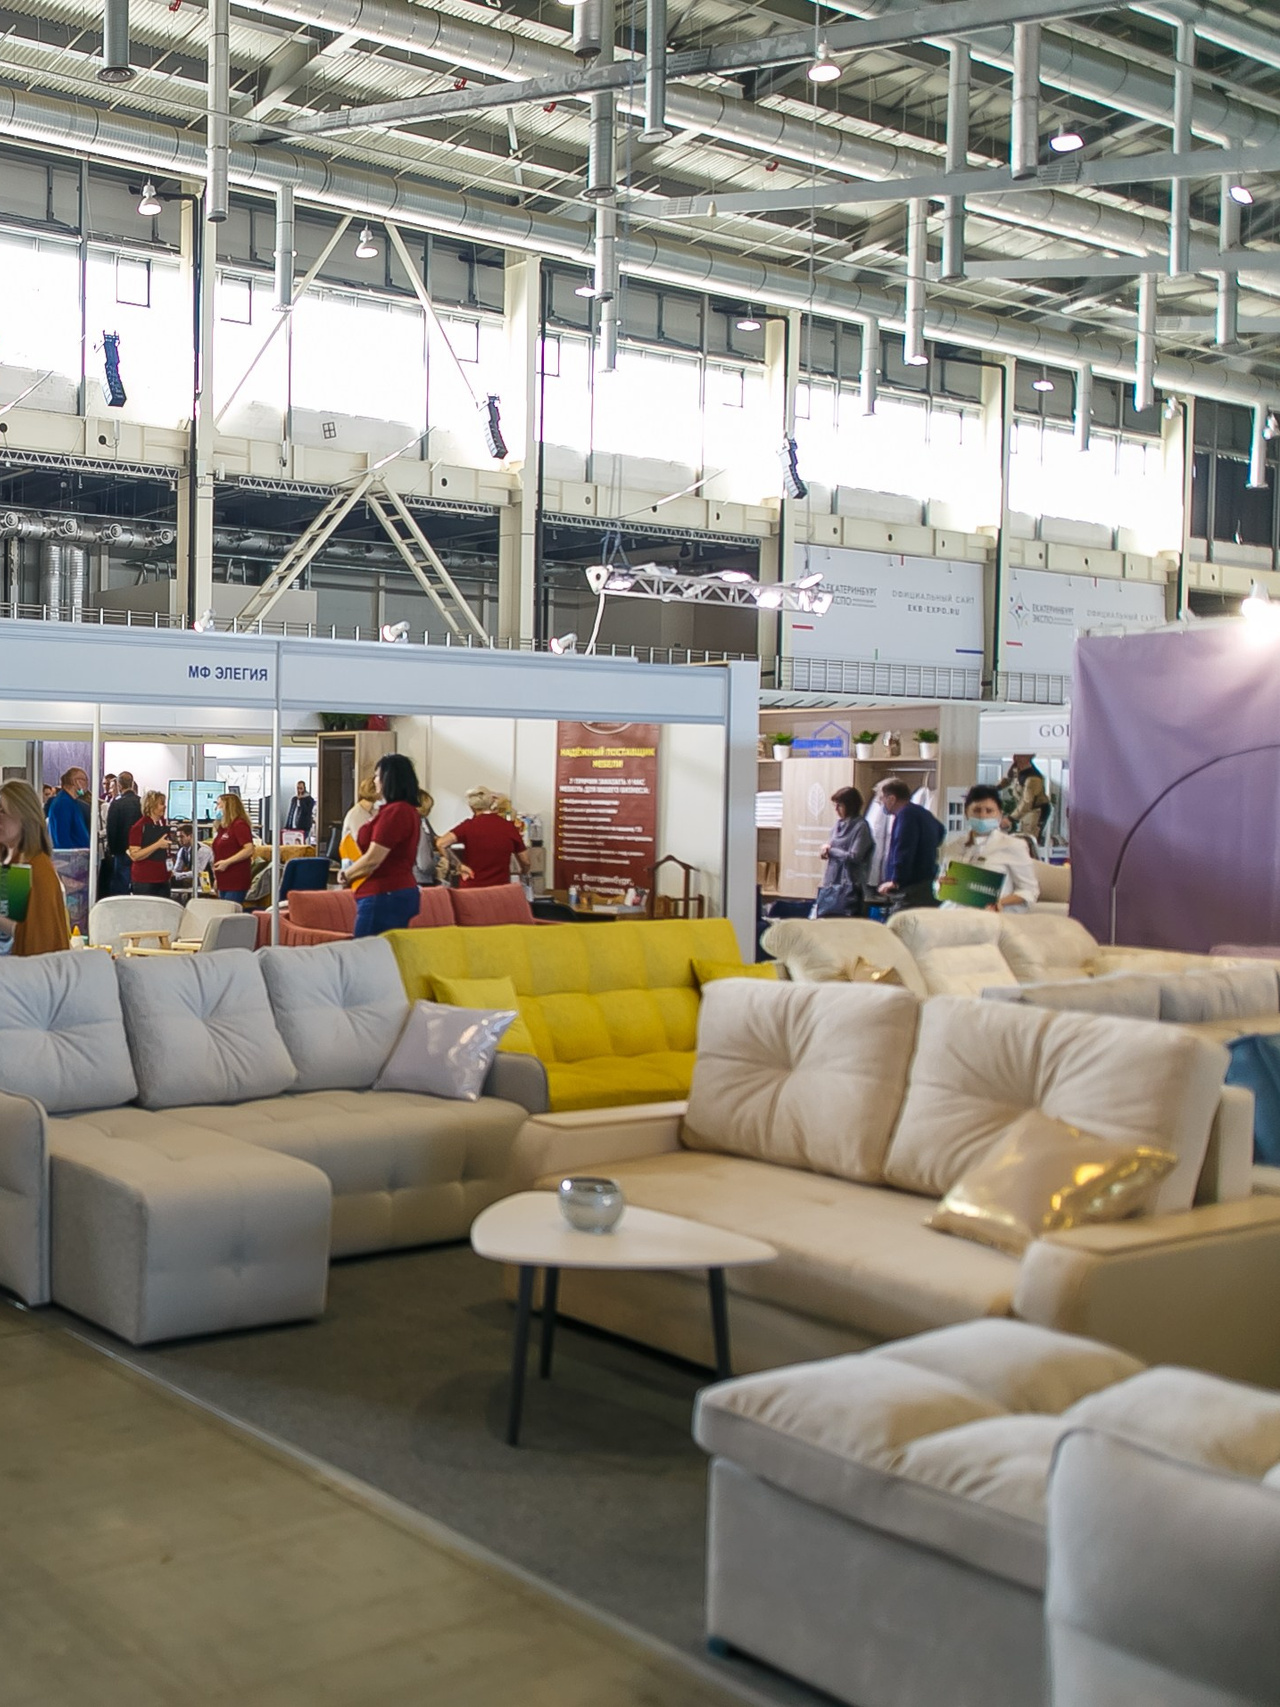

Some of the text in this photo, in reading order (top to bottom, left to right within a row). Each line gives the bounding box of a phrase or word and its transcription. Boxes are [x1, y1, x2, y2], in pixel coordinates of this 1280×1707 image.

[826, 583, 878, 596] ЕКАТЕРИНБУРГ
[892, 589, 953, 603] ОФИЦИАЛЬНЫЙ
[188, 665, 268, 681] МФ ЭЛЕГИЯ
